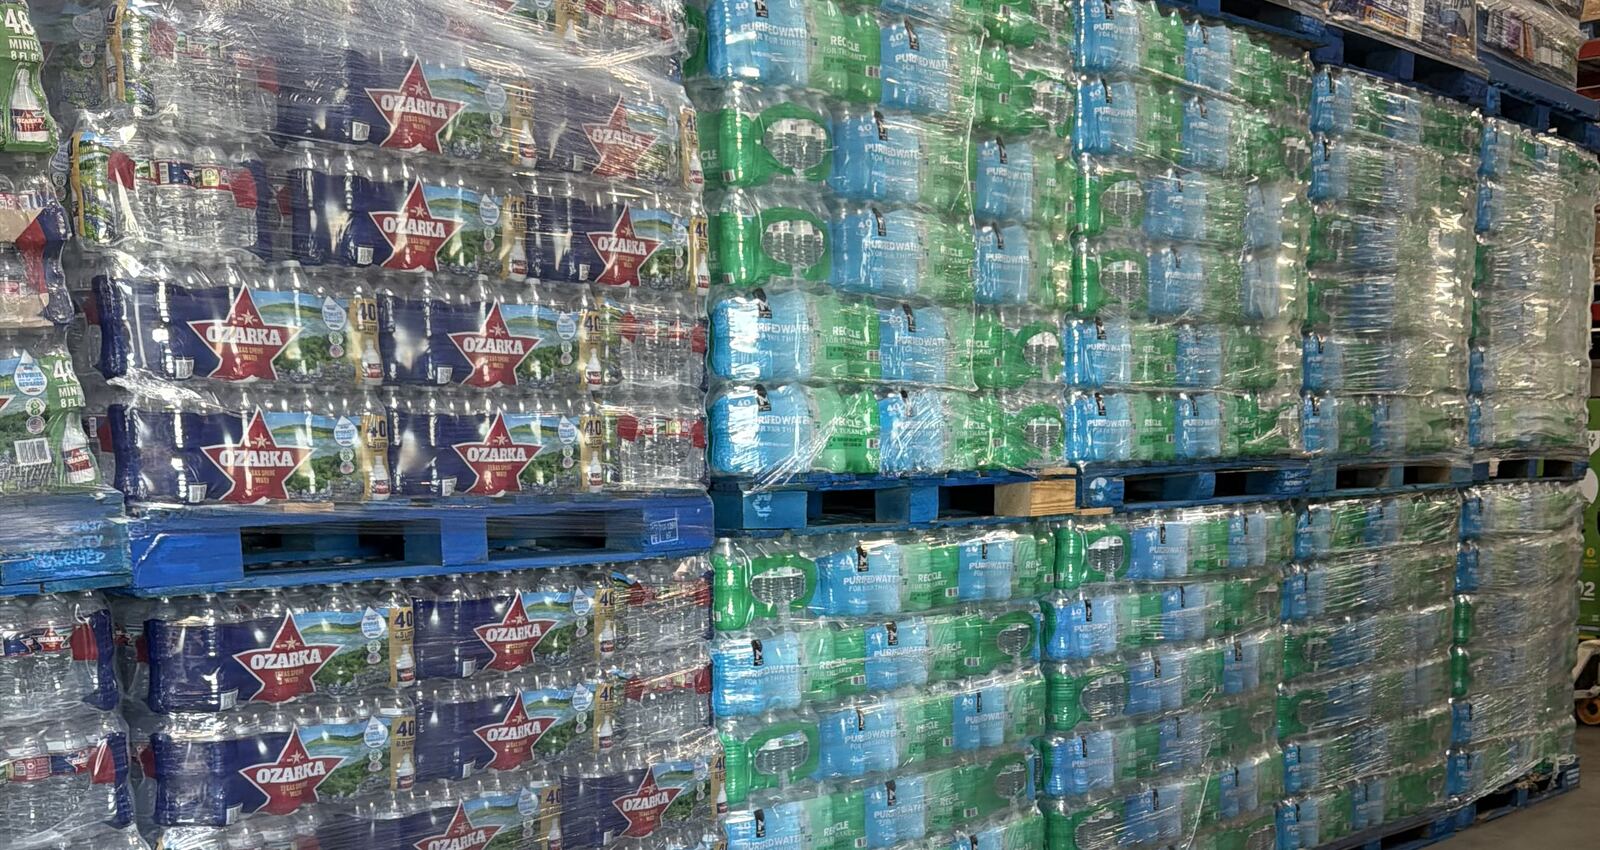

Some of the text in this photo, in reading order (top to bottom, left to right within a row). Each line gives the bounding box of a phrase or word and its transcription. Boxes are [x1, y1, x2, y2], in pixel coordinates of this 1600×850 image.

[5, 9, 35, 35] 48
[740, 22, 807, 39] PURIFED WATE
[9, 39, 39, 51] MINIS
[830, 35, 860, 53] RECCLE
[11, 51, 18, 60] 8
[380, 94, 447, 119] OZARKA
[382, 216, 446, 238] OZARKA
[597, 236, 647, 255] OZARKA
[584, 311, 601, 332] 40
[780, 323, 810, 334] WATE
[205, 326, 283, 346] OZARKA
[832, 326, 861, 338] RECCLE
[462, 336, 524, 355] OZARKA
[53, 360, 80, 385] 48
[60, 398, 67, 408] 8
[584, 419, 601, 436] 40
[779, 415, 809, 425] WATE
[219, 450, 295, 467] OZARKA
[467, 447, 527, 462] OZARKA
[843, 575, 875, 585] PURIED
[918, 571, 943, 582] RECCLE
[394, 611, 413, 628] 40
[485, 624, 542, 642] OZARKA
[250, 648, 322, 670] OZARKA
[769, 664, 800, 674] WATE
[396, 720, 415, 736] 40
[486, 722, 542, 742] OZARKA
[256, 761, 326, 783] OZARKA
[546, 788, 561, 804] 40
[622, 793, 669, 812] OZARKA
[427, 830, 486, 850] OZARKA
[772, 835, 801, 846] WATE
